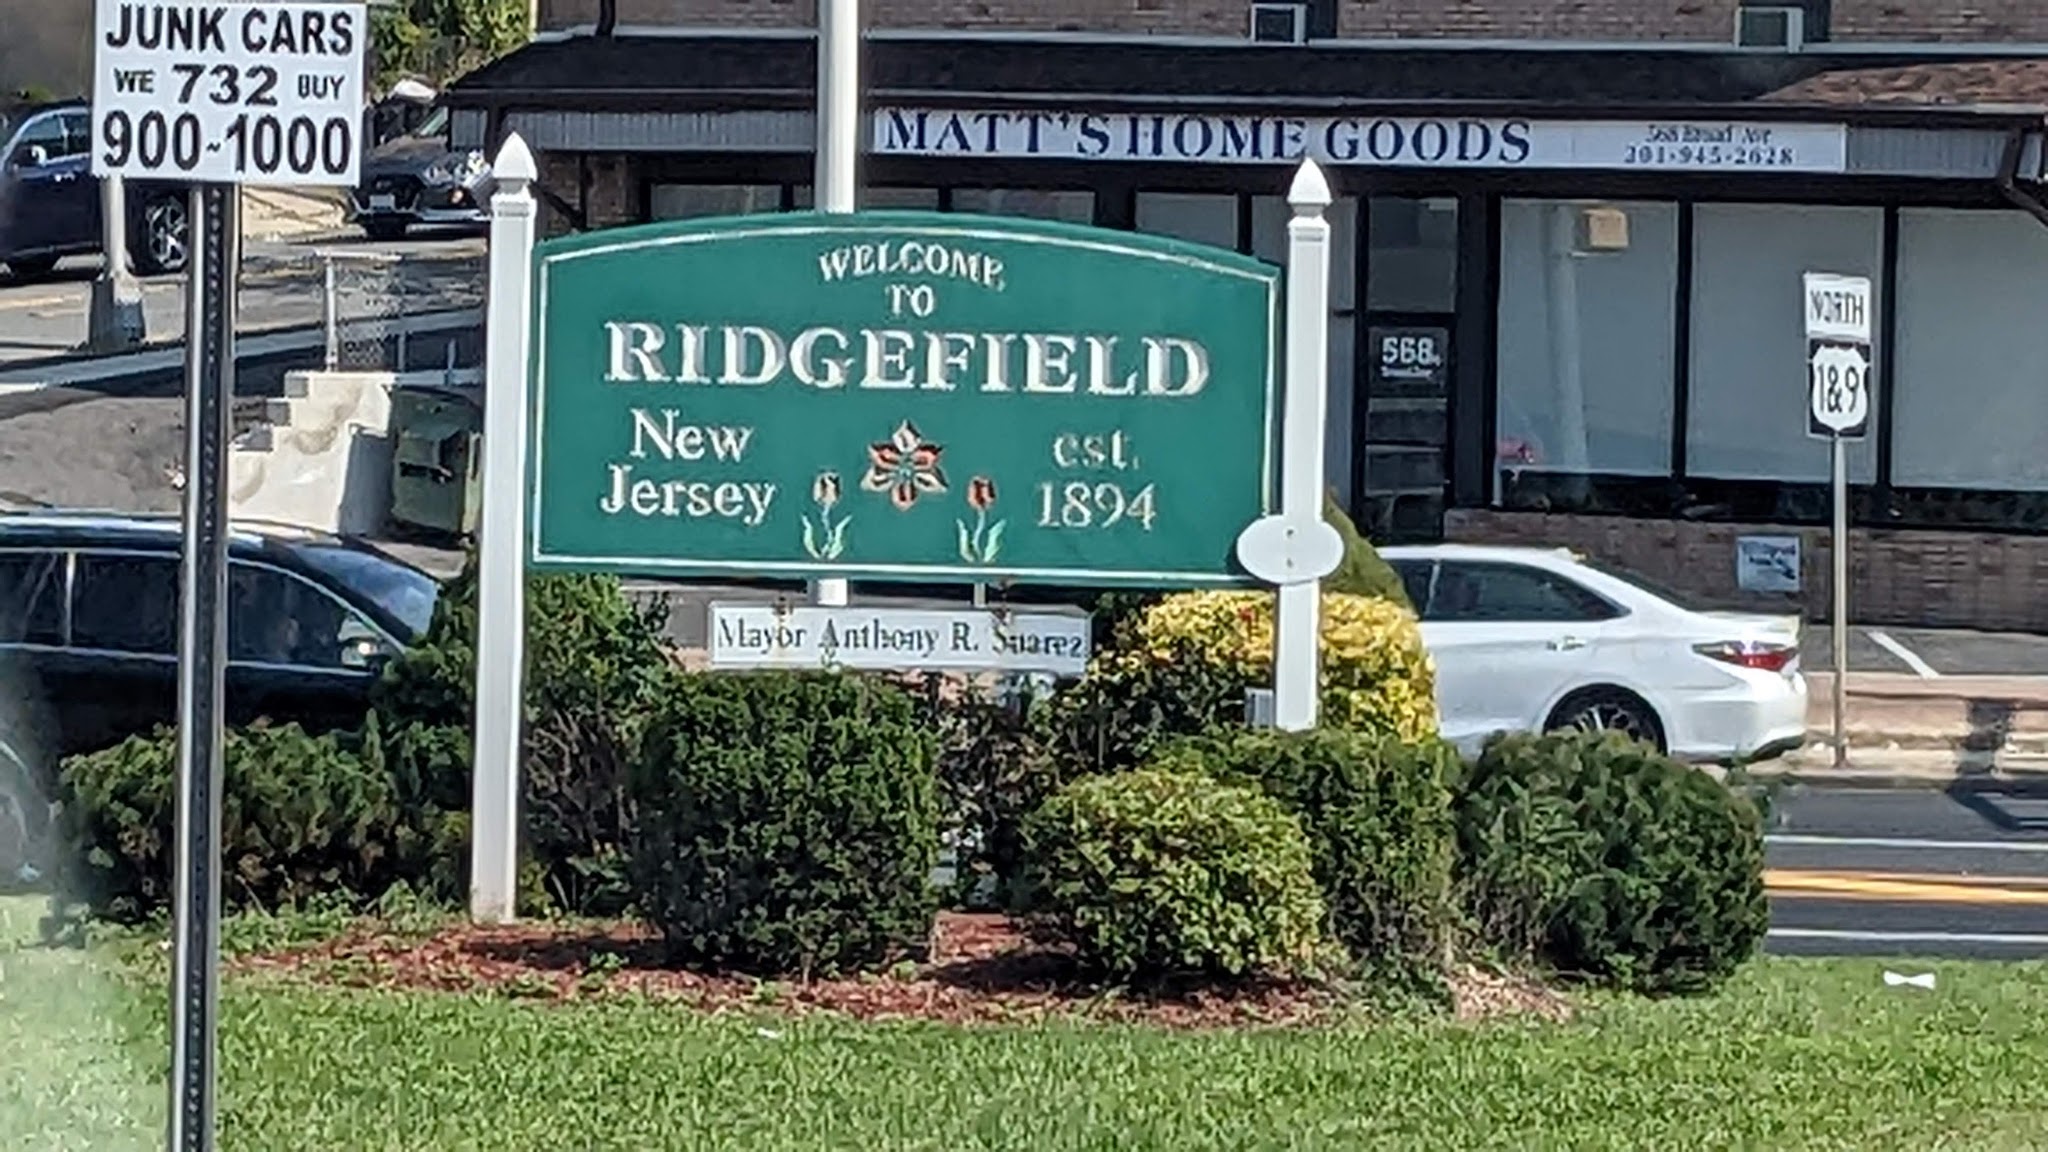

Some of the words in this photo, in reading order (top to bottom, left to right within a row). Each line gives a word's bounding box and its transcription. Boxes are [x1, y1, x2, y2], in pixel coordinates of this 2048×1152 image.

[106, 5, 228, 50] JUNK
[241, 7, 354, 56] CARS
[113, 67, 155, 93] WE
[171, 63, 279, 106] 732
[297, 73, 346, 100] BUY
[885, 110, 1111, 155] MATT'S
[1126, 113, 1307, 160] HOME
[1325, 118, 1532, 163] GOODS
[818, 240, 1005, 290] WELCOME
[888, 282, 936, 317] TO
[1809, 290, 1865, 327] NORTH
[603, 320, 1210, 398] RIDGEFIELD
[1817, 364, 1860, 414] 1&9
[630, 407, 754, 462] New
[1052, 430, 1140, 470] est.
[601, 464, 776, 526] Jersey
[1036, 480, 1157, 531] 1894
[718, 618, 808, 655] Mayor
[818, 617, 940, 657] Anthony
[951, 621, 980, 652] R.
